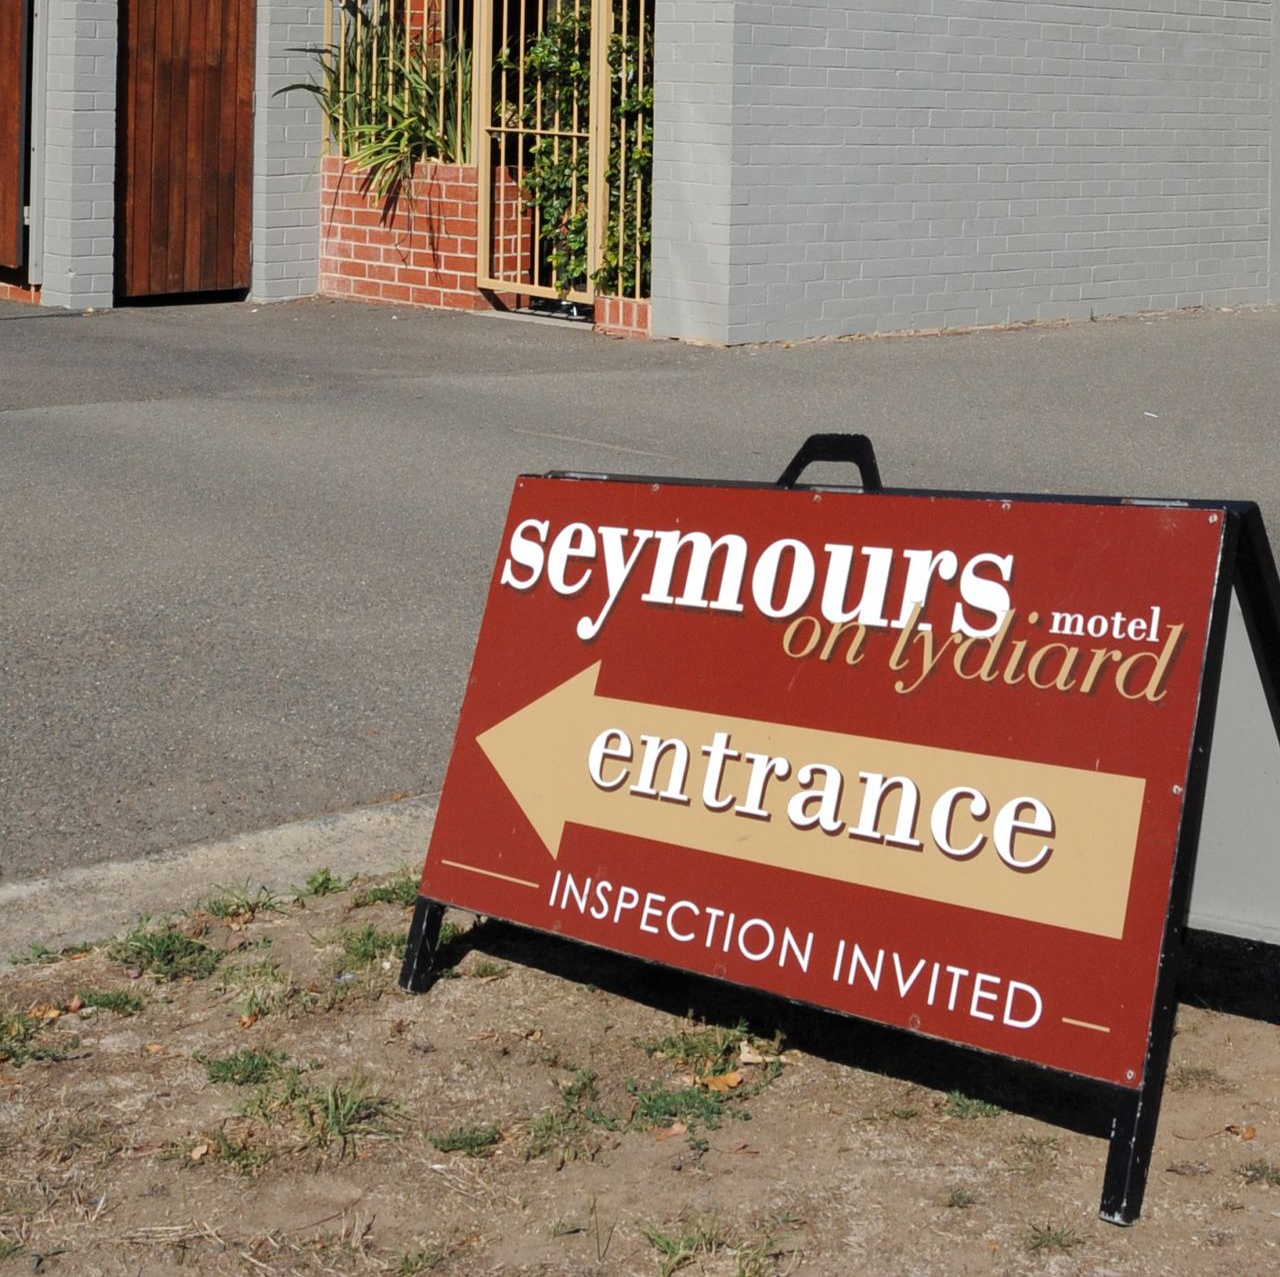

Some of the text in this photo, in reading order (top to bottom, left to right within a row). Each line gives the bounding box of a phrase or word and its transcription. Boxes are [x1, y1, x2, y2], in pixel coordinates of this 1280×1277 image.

[500, 519, 1014, 640] seymours
[1049, 606, 1162, 643] motel
[782, 600, 1187, 703] on lydiard
[588, 727, 1056, 871] entrance
[549, 870, 1044, 1031] INSPECTION INVITED
